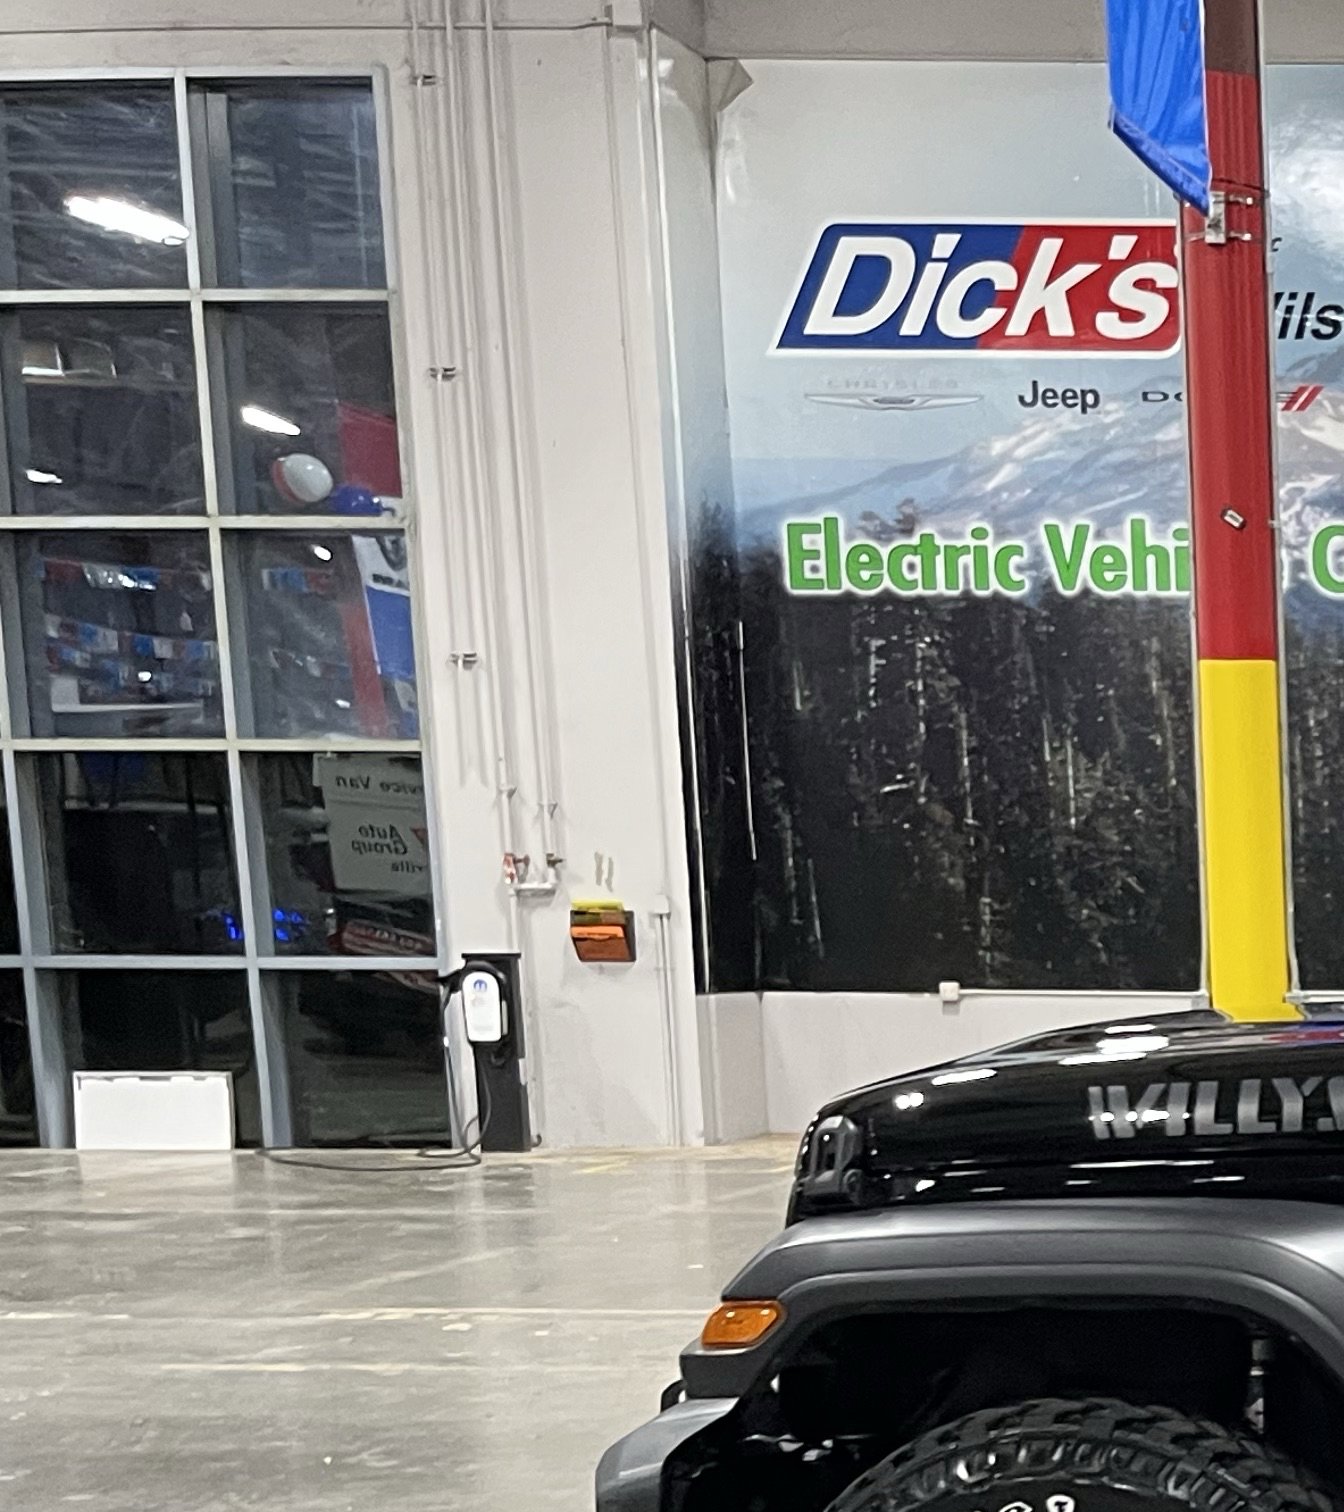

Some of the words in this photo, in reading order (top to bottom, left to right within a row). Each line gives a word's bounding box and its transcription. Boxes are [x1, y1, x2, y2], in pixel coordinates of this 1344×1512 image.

[803, 233, 1178, 340] Dick's
[1018, 380, 1100, 414] Jeep
[786, 516, 1026, 593] Electric
[1043, 517, 1191, 593] Vehi
